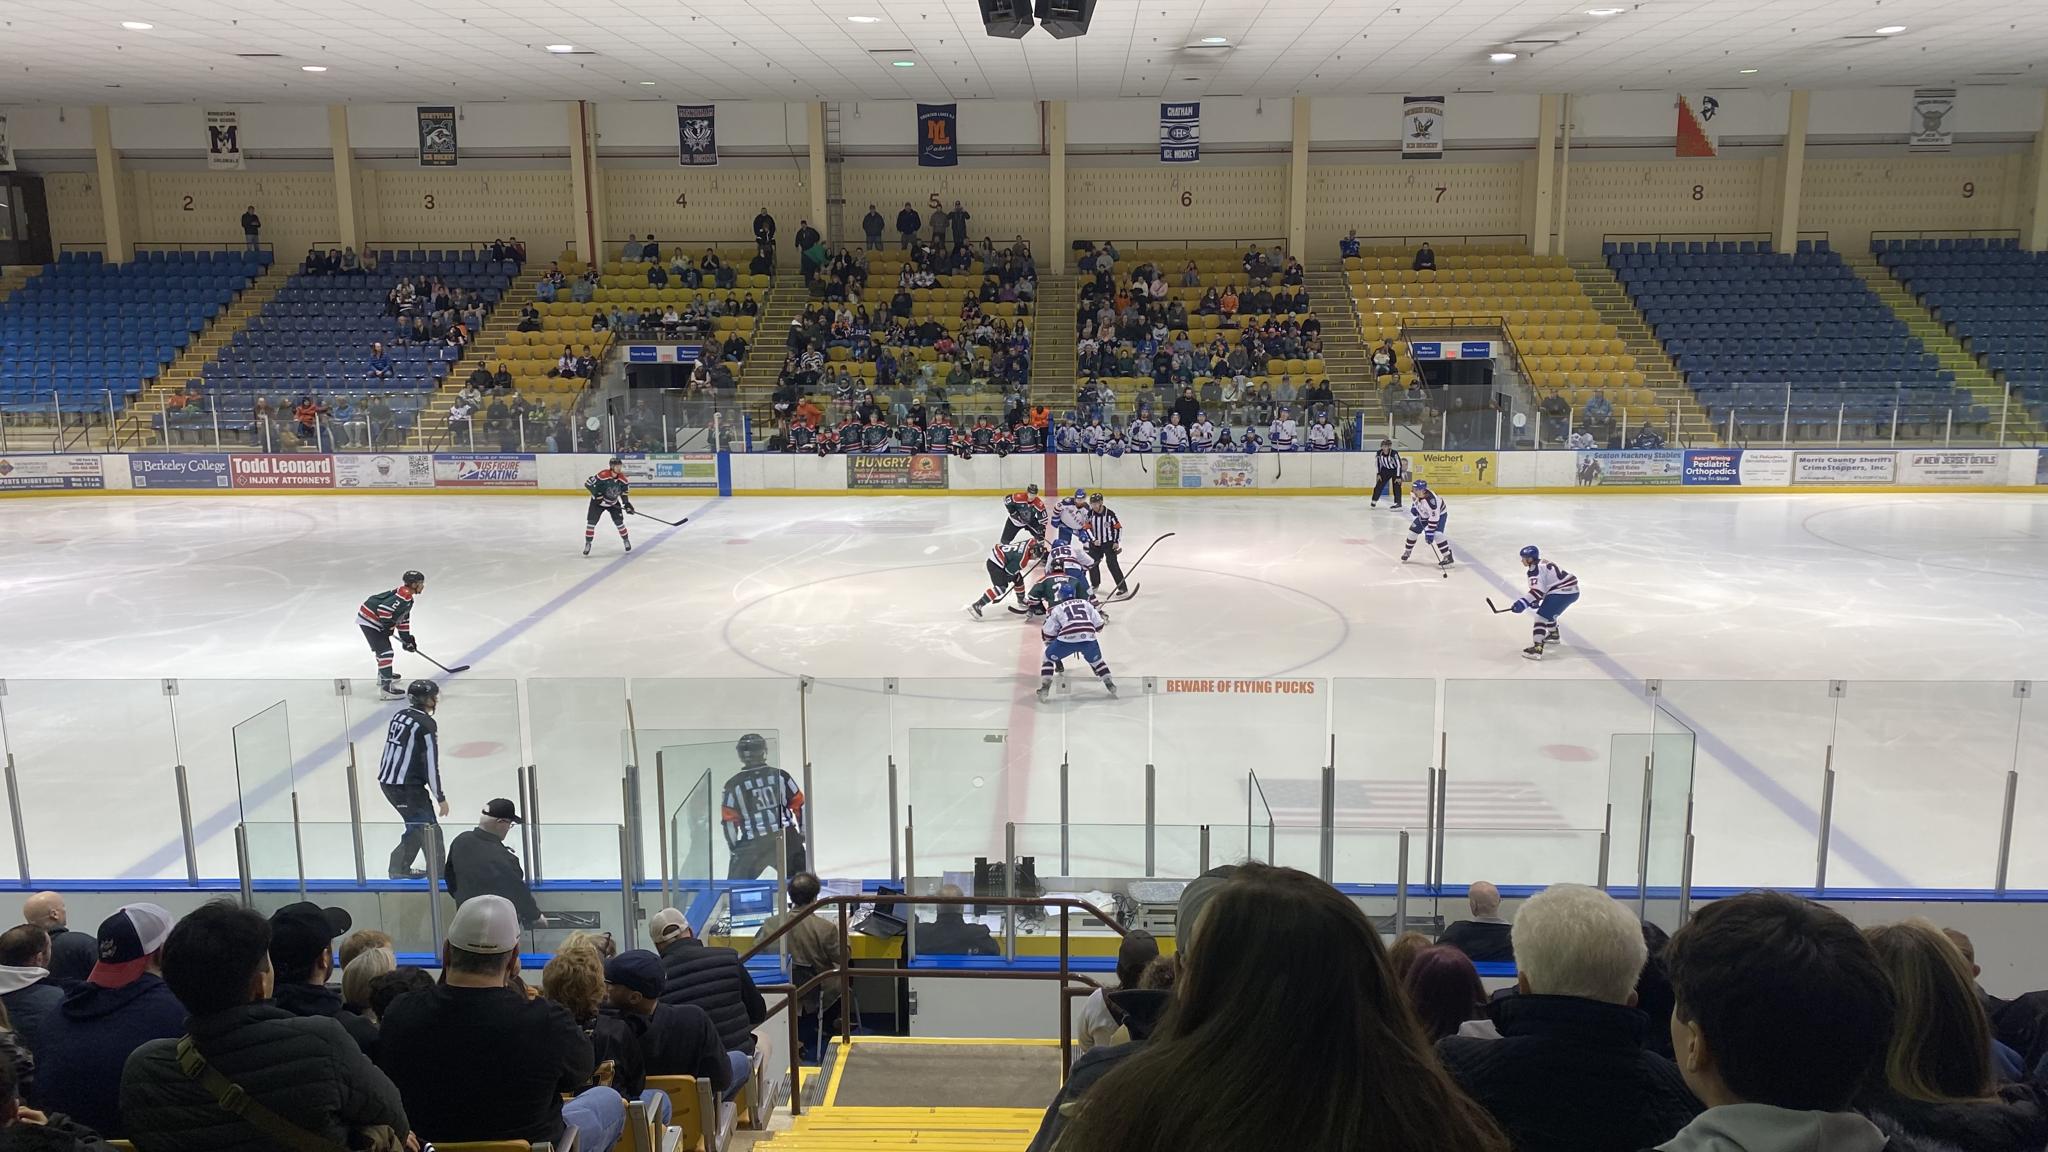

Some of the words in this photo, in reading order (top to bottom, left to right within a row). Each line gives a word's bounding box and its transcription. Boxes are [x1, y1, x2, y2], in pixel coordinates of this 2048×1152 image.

[1435, 188, 1446, 203] 7
[1692, 185, 1703, 200] 8
[1963, 182, 1974, 198] 9
[183, 196, 194, 210] 2
[424, 195, 435, 209] 3
[676, 193, 687, 208] 4
[929, 193, 939, 208] 5
[1181, 192, 1192, 206] 6
[855, 456, 912, 467] HUNGRY?
[1423, 454, 1464, 462] Weichert
[1924, 456, 1940, 464] NEW
[1942, 456, 1968, 464] JERSEY
[1970, 456, 1996, 464] DEVILS
[145, 460, 186, 473] Berkeley
[188, 460, 225, 473] College
[233, 458, 269, 473] Todd
[273, 458, 330, 473] Leonard
[1686, 468, 1736, 476] Orthopedics
[480, 470, 518, 479] SKATING
[392, 600, 400, 609] 2
[1064, 603, 1089, 621] 15
[1166, 680, 1214, 692] BEWARE
[1217, 680, 1232, 692] OF
[1234, 681, 1272, 693] FLYING
[1275, 681, 1314, 693] PUCKS
[752, 786, 778, 810] 30
